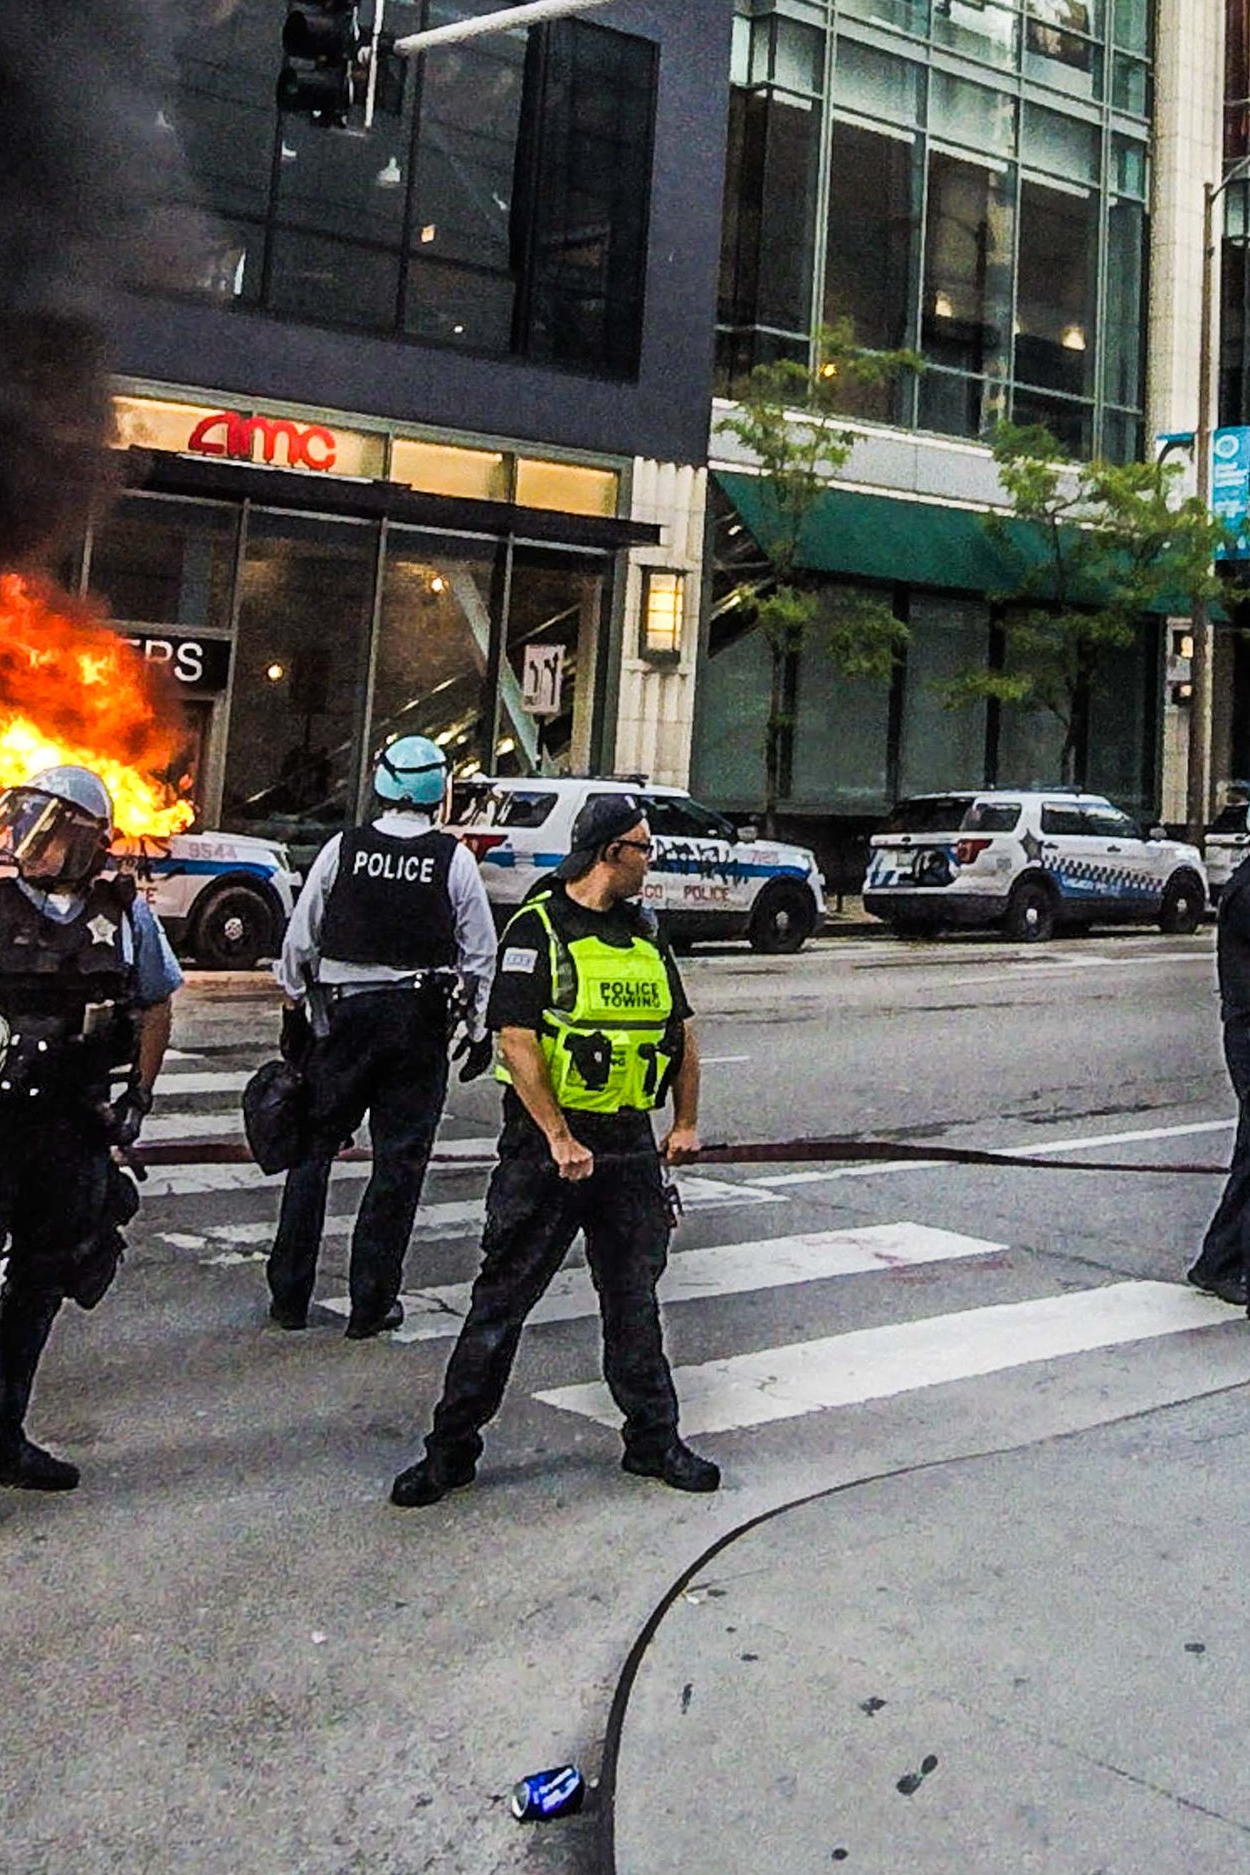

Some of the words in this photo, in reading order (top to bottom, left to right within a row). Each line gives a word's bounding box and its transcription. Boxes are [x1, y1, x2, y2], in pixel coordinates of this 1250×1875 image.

[352, 850, 435, 883] POLICE
[683, 885, 731, 901] POLICE
[600, 982, 659, 997] POLICE
[603, 996, 661, 1008] TOWING
